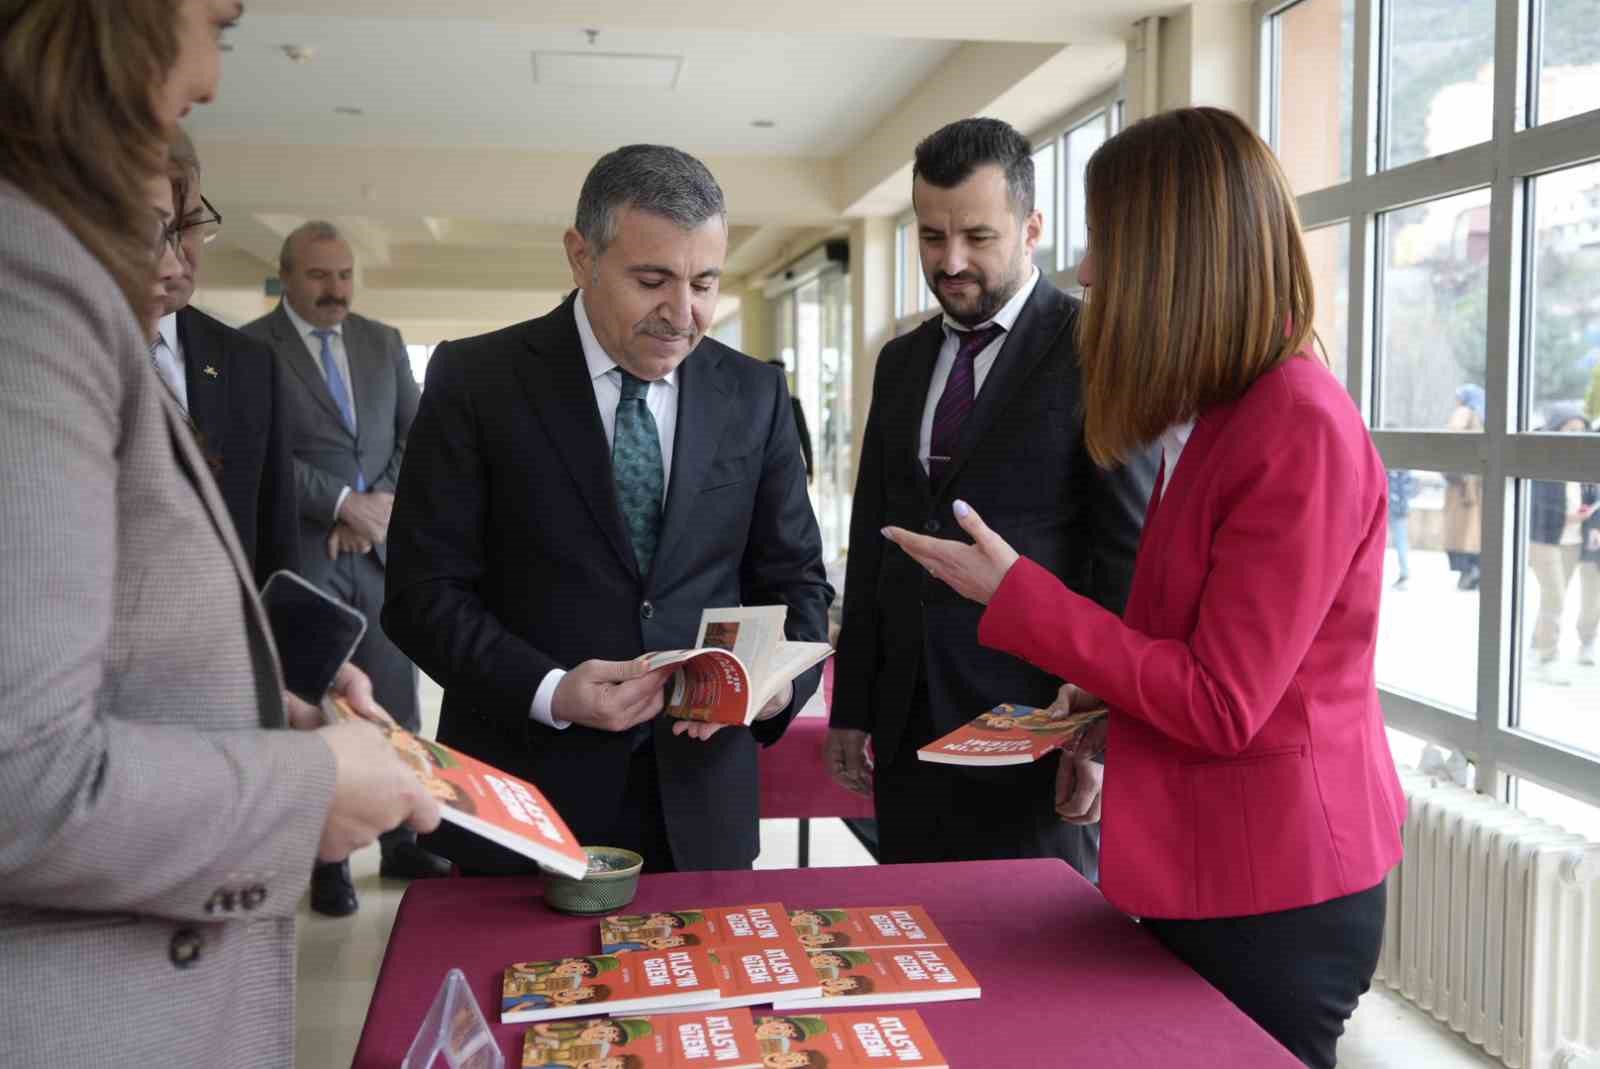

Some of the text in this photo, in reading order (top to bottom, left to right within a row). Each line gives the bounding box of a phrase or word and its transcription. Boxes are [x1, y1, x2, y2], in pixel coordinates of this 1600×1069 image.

[667, 951, 699, 988] ATLAS'IN
[763, 949, 800, 985] ATLAS'IN
[704, 1016, 740, 1061] ATLAS'IN
[876, 1016, 924, 1061] ATLAS'IN
